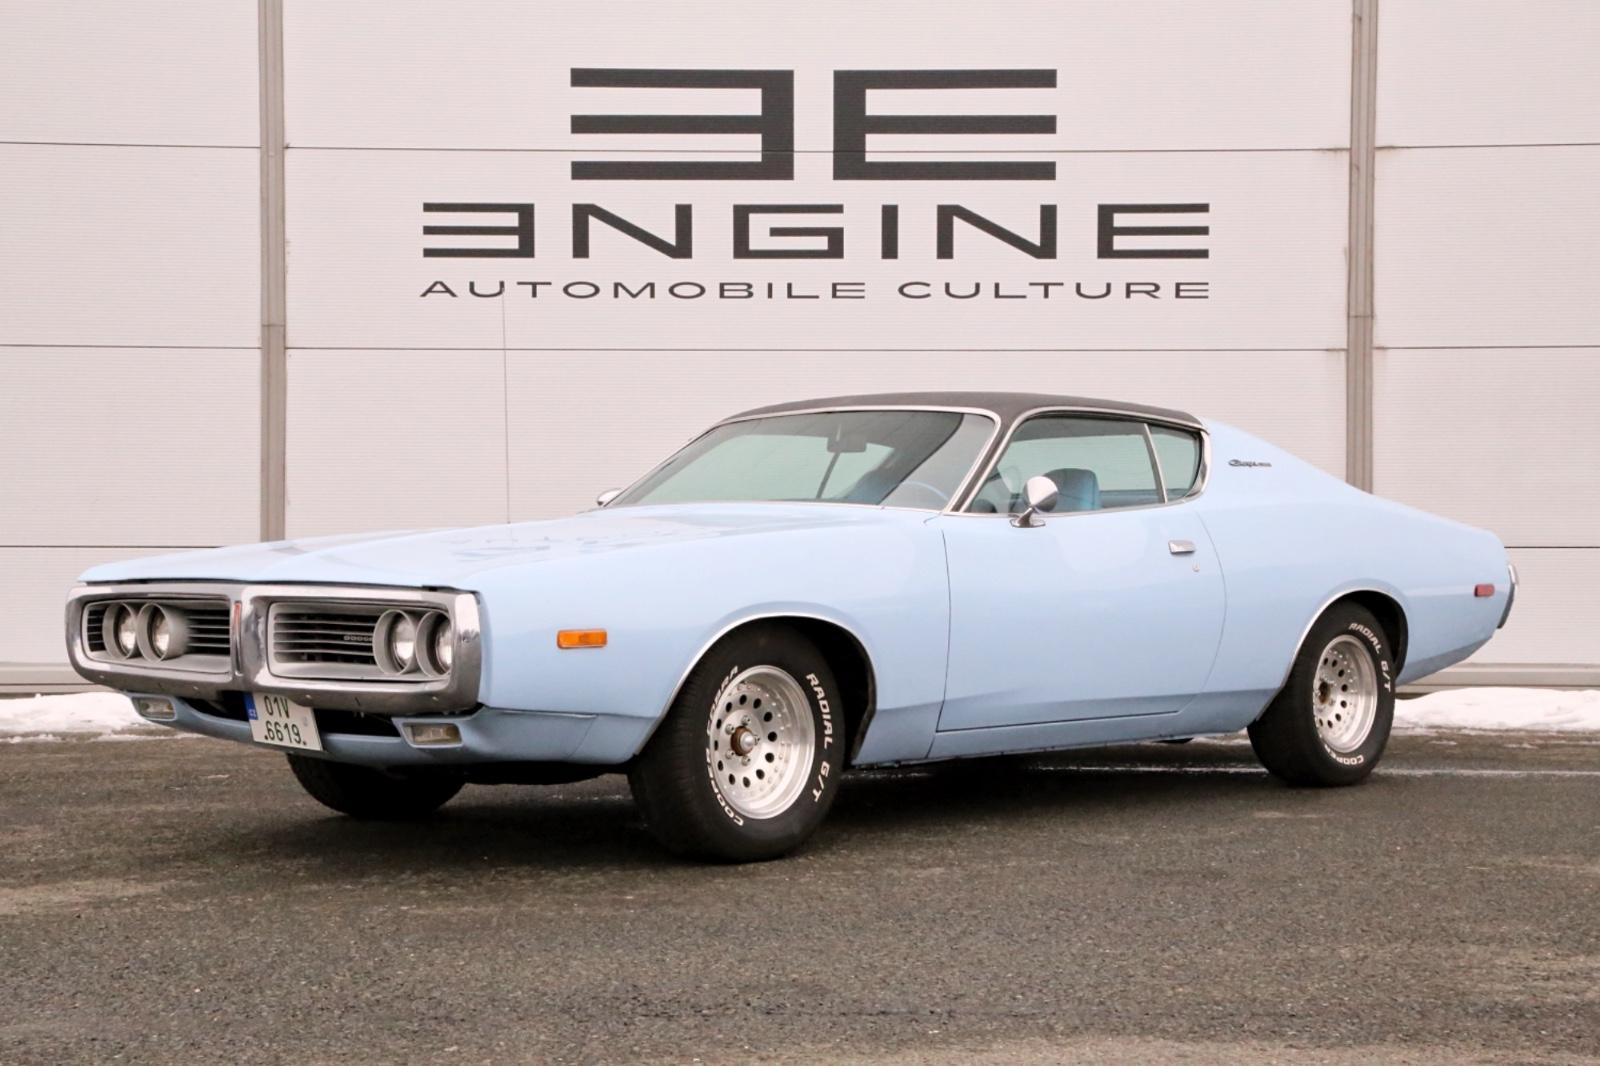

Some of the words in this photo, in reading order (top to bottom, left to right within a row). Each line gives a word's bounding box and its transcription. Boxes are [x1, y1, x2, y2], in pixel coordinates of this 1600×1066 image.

[421, 281, 865, 299] AUTOMOBILE
[898, 281, 1209, 299] CULTURE
[1349, 622, 1380, 654] RADIAL
[806, 673, 833, 749] RADIAL
[813, 761, 830, 802] G/T
